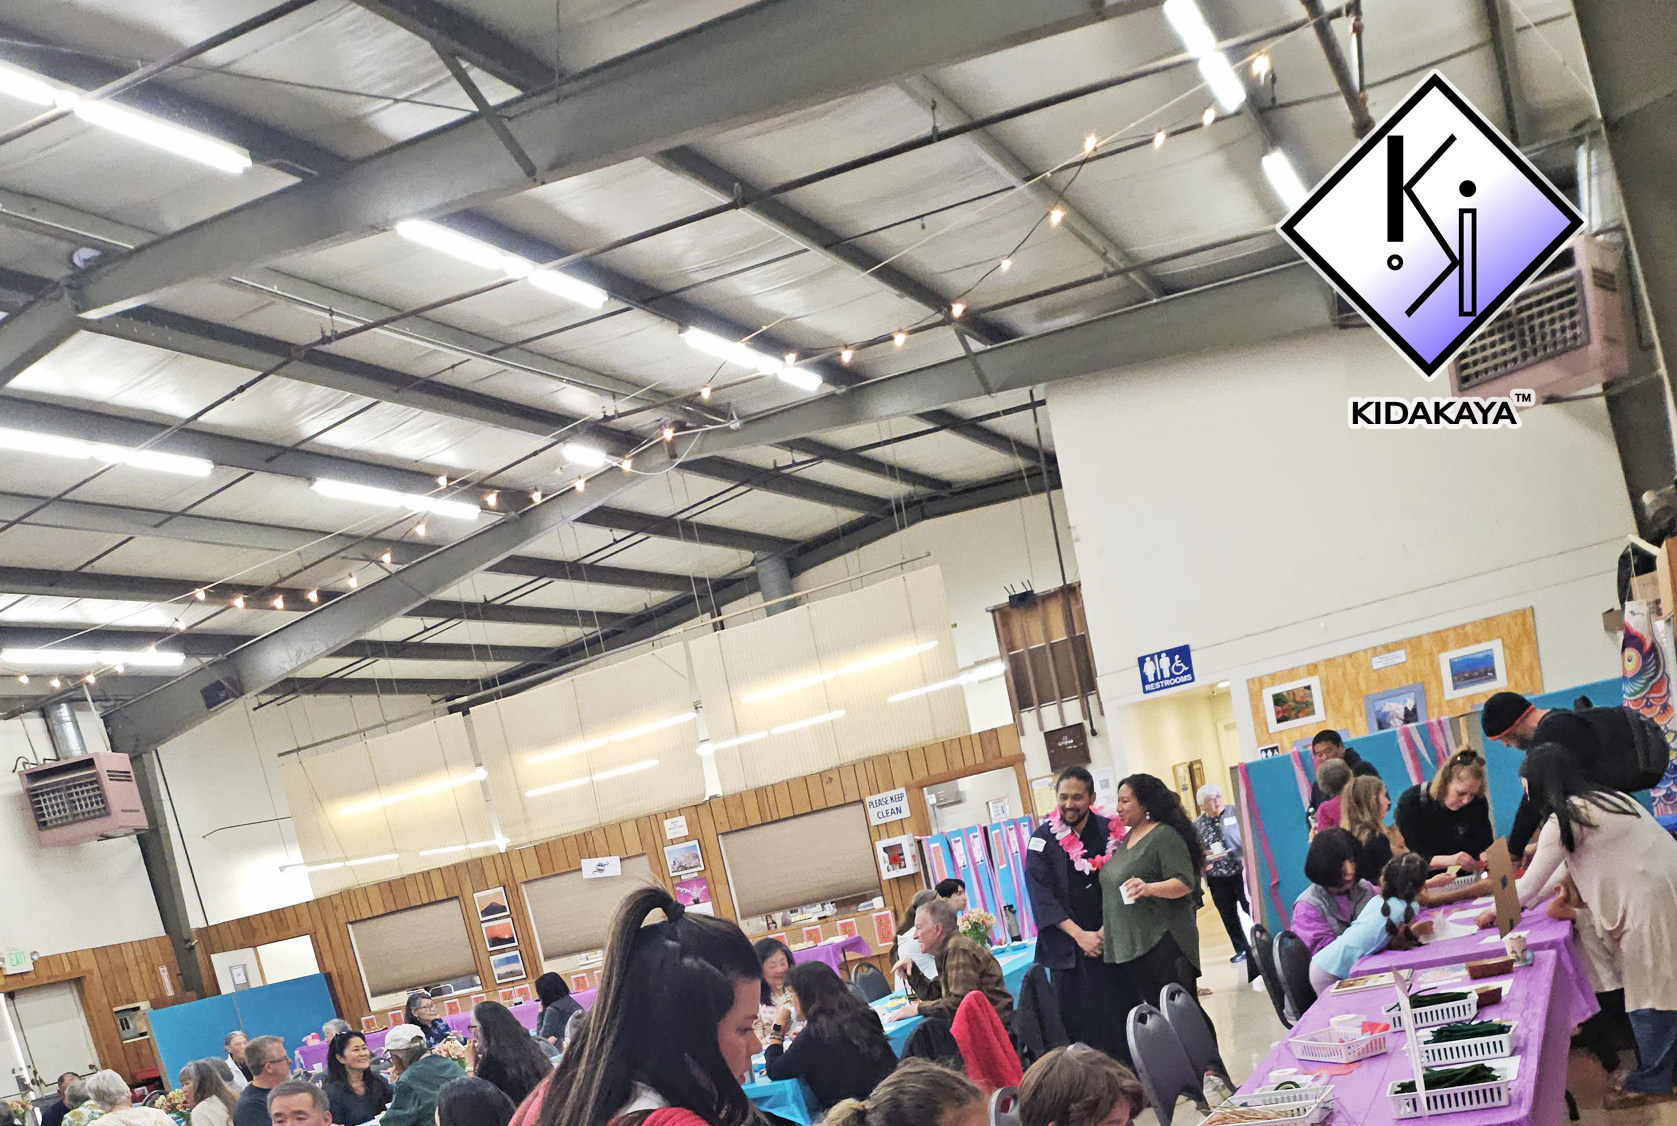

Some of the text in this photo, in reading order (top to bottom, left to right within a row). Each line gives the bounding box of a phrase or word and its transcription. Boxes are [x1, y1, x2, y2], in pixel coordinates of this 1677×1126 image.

[1145, 674, 1193, 691] RESTROOMS
[868, 792, 905, 809] PLEASE KEEP
[876, 806, 902, 819] CLEAN
